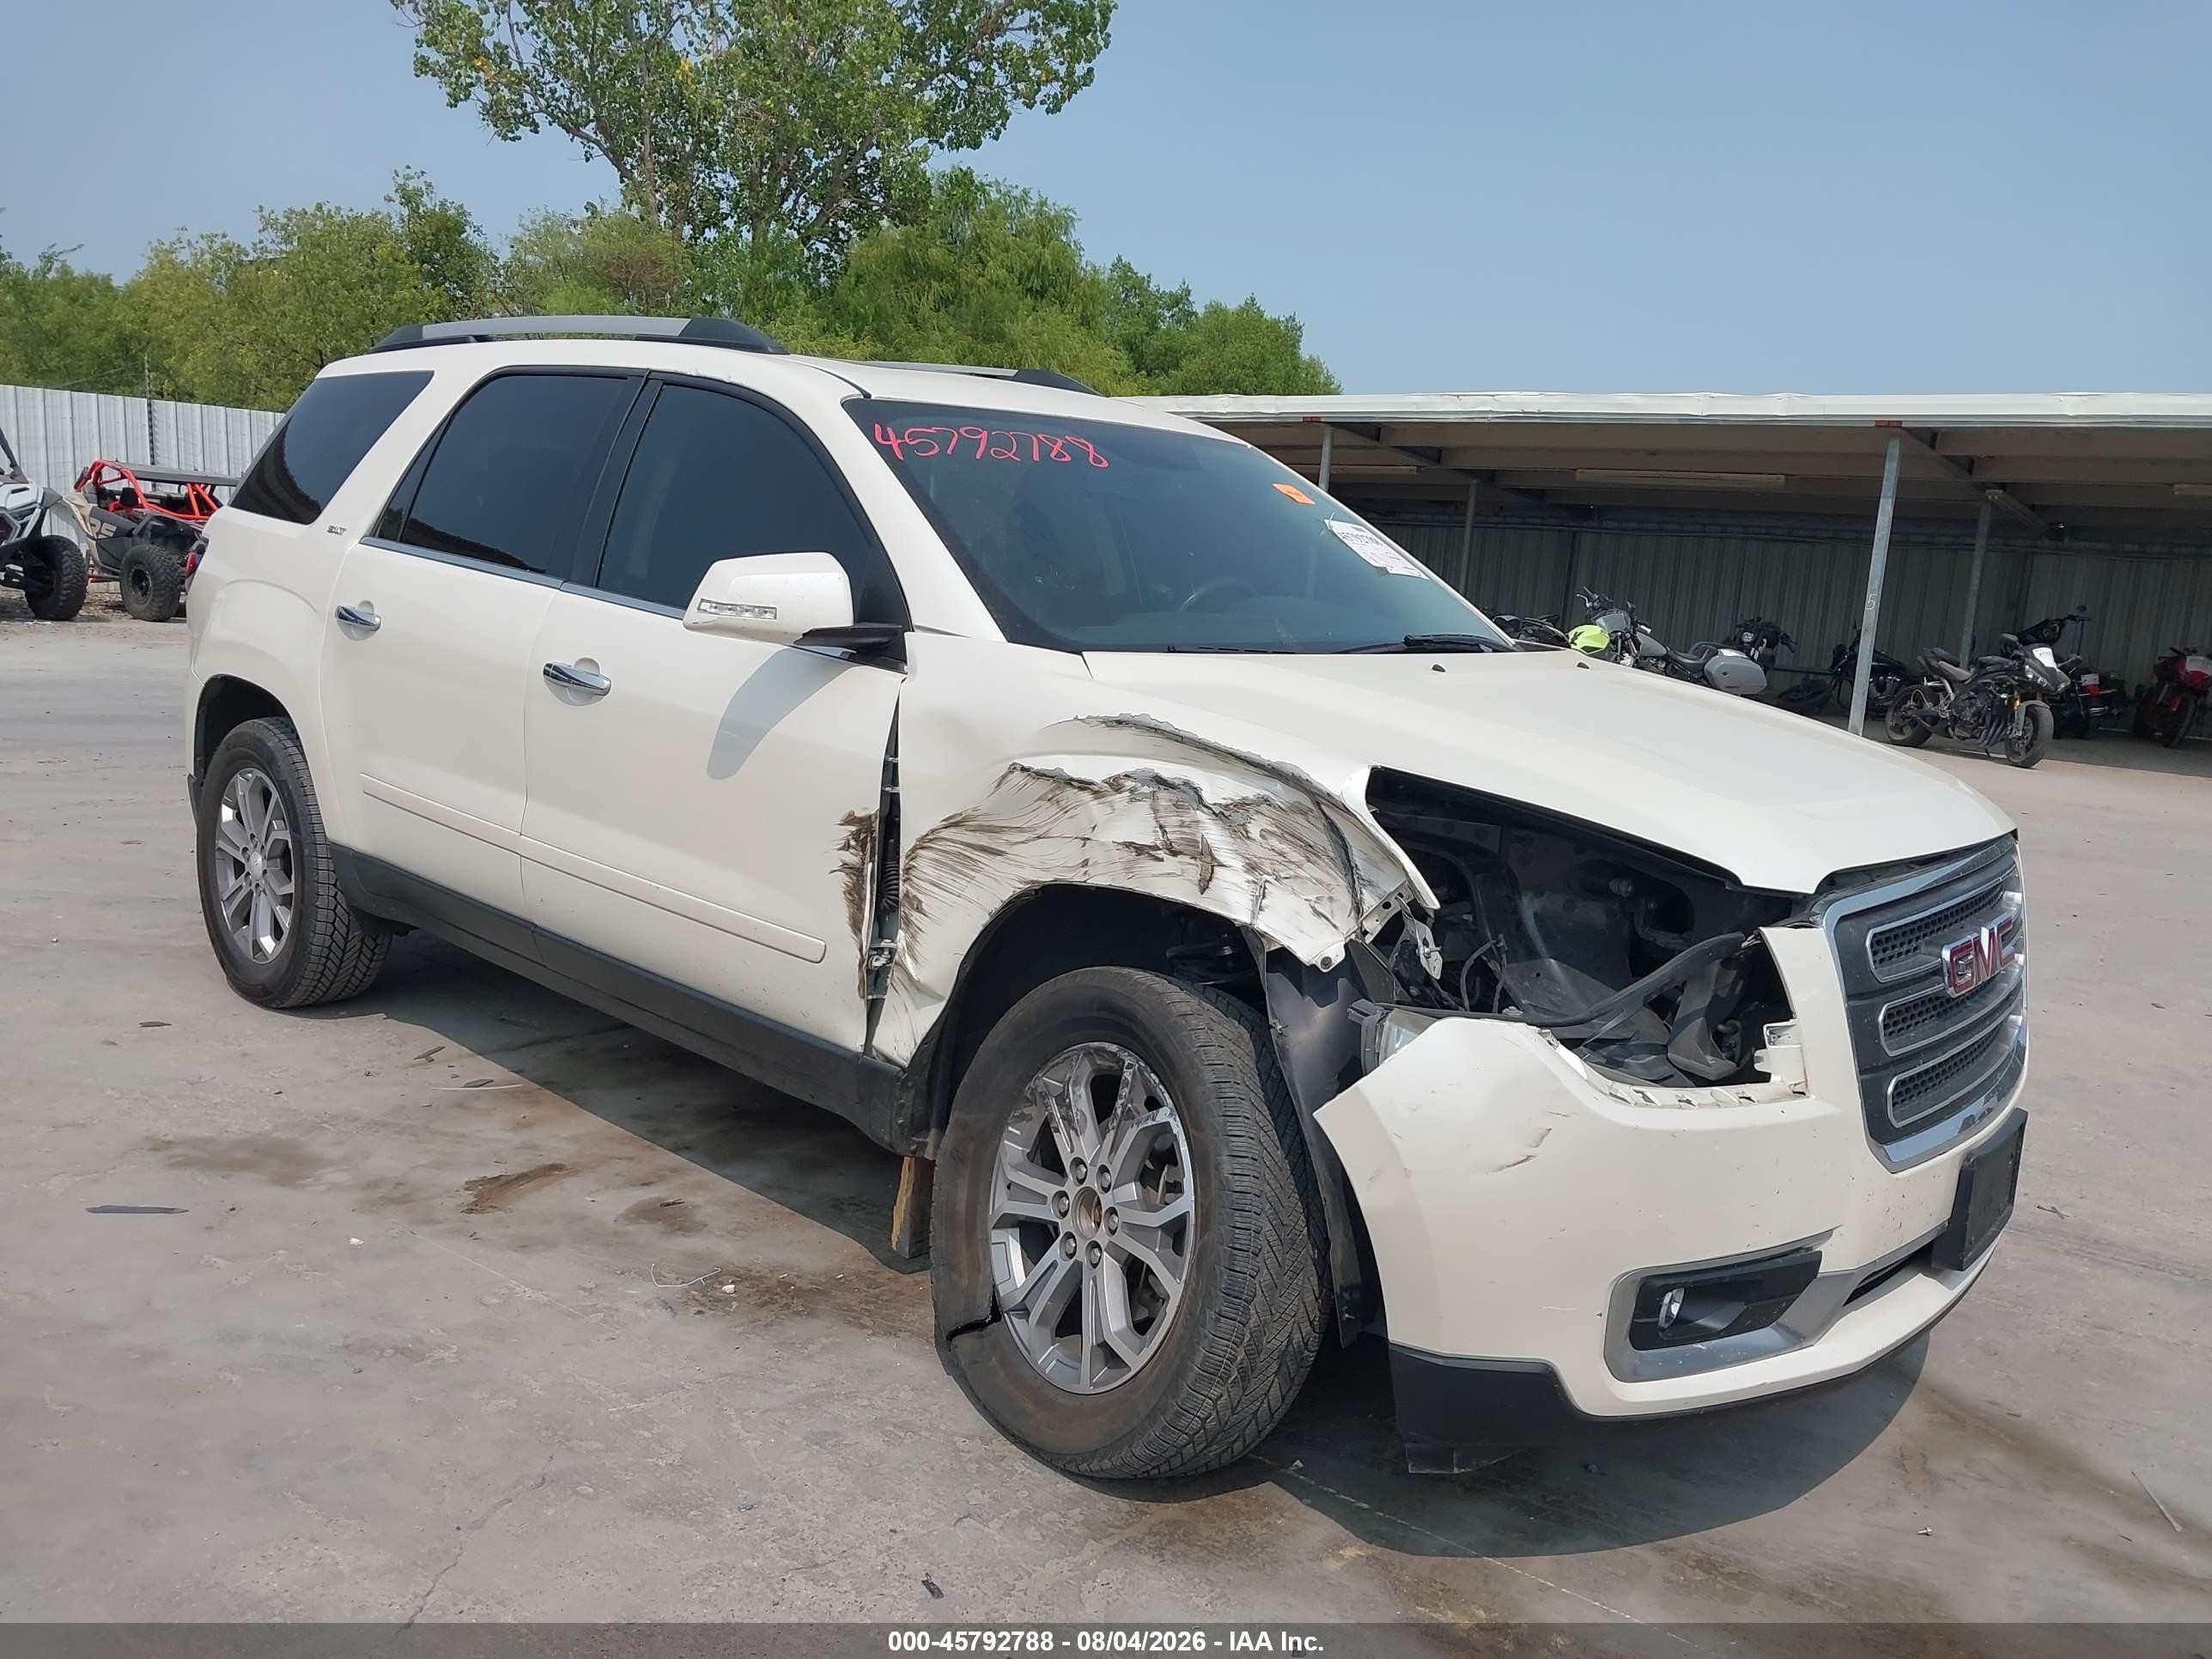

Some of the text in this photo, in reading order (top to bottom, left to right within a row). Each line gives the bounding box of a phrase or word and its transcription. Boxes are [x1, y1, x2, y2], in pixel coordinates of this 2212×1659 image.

[873, 422, 1109, 468] 45792788
[1864, 593, 1877, 611] 5
[1942, 911, 2015, 998] GMC
